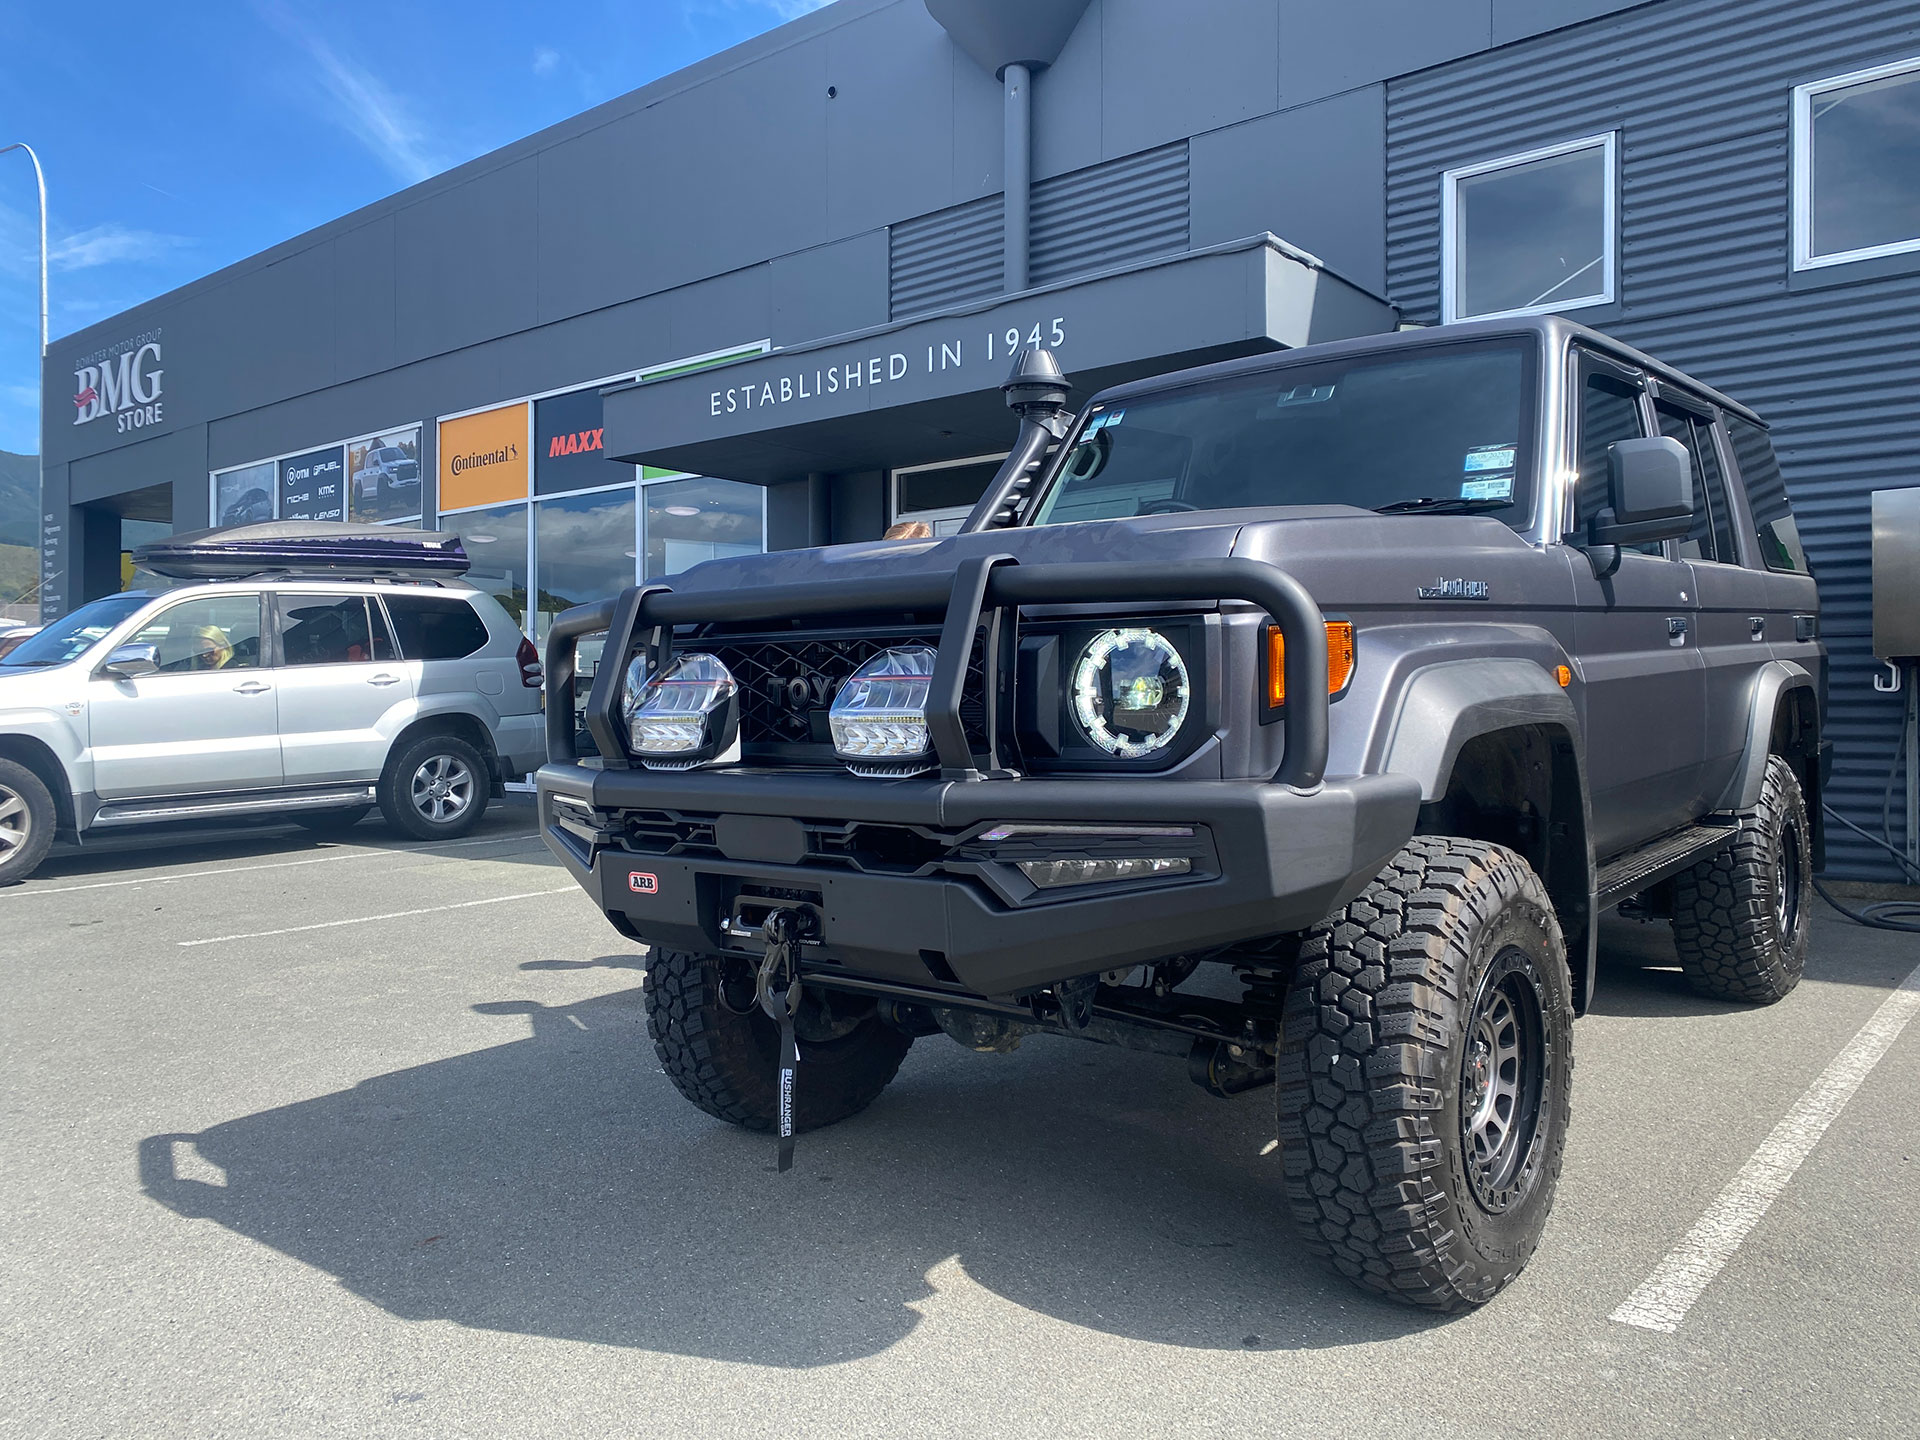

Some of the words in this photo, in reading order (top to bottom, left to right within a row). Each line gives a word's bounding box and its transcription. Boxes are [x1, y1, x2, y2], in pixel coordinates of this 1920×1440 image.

[108, 338, 134, 358] MOTOR
[135, 327, 162, 347] GROUP
[710, 353, 908, 416] ESTABLISHED
[928, 340, 962, 372] IN
[987, 317, 1066, 361] 1945
[73, 343, 164, 425] BMG
[117, 403, 163, 433] STORE
[451, 446, 509, 476] Continental
[313, 508, 340, 520] LENSO
[632, 876, 654, 889] ARB
[784, 1068, 793, 1137] BUSHRANGER
